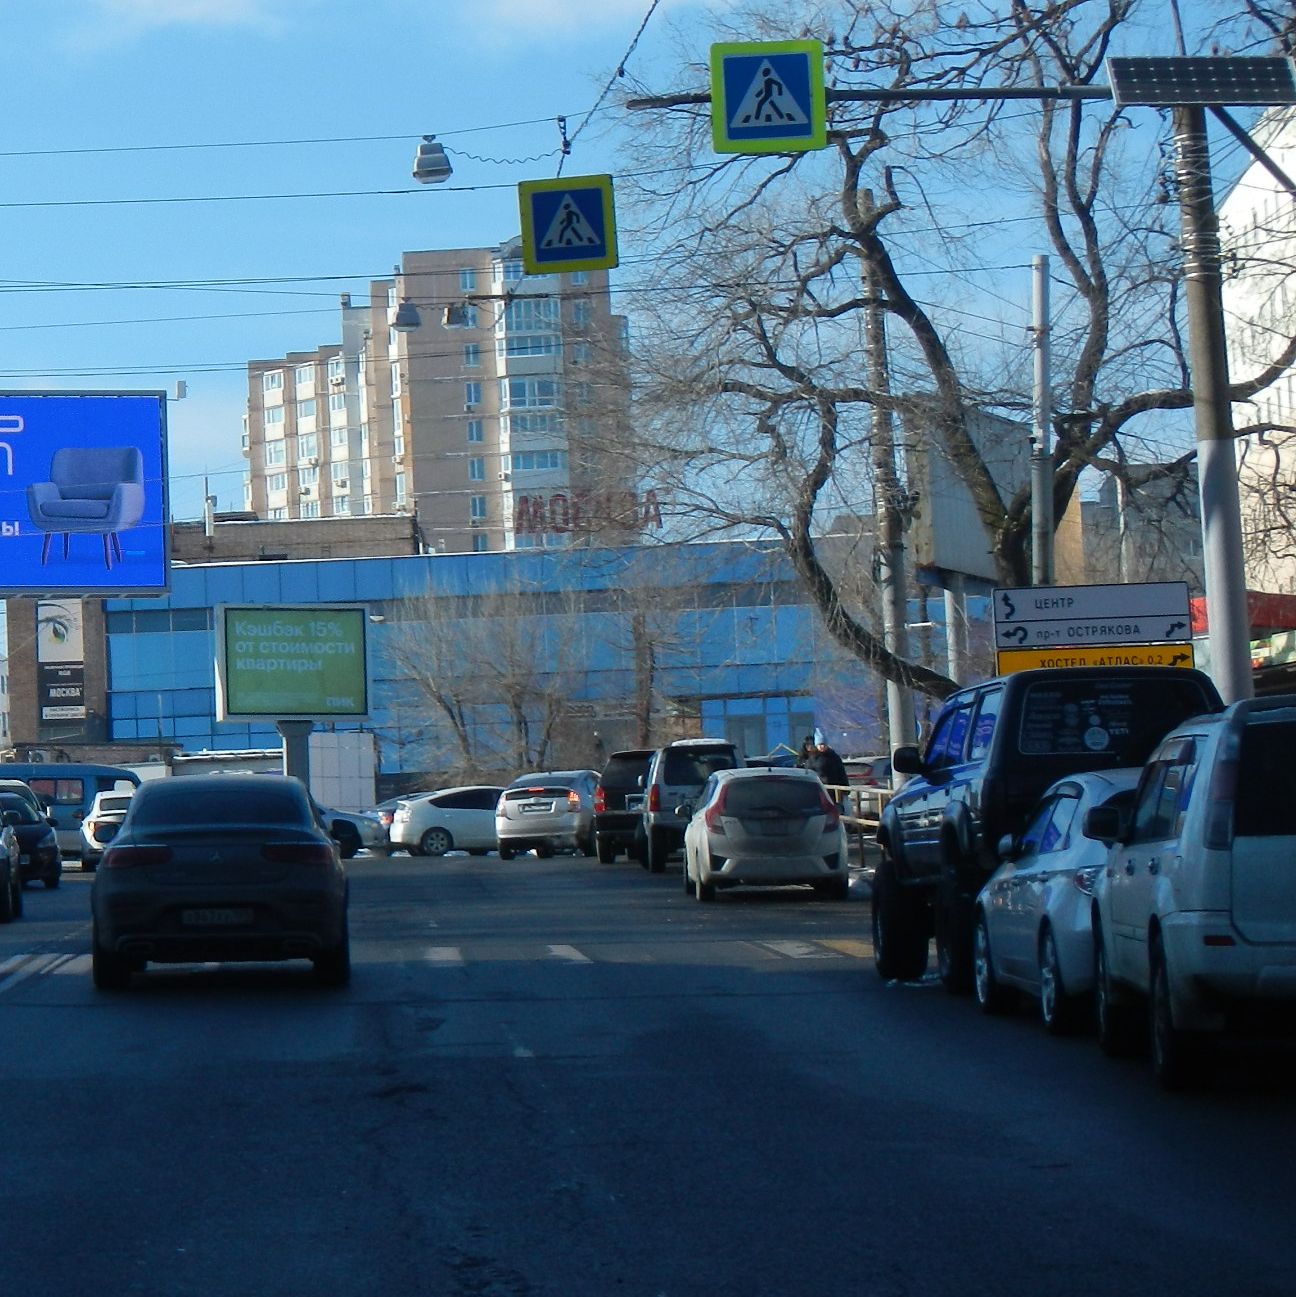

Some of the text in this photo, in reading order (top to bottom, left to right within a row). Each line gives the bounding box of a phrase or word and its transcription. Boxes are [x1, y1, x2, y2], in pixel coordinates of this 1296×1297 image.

[1034, 597, 1074, 610] ЦЕНТР
[235, 621, 344, 638] Кэшбэк 15%
[1037, 624, 1141, 640] пр-т ОСТРЯКОВА
[235, 641, 355, 655] от стоимости
[236, 658, 323, 673] квартиры
[1147, 655, 1164, 665] 02
